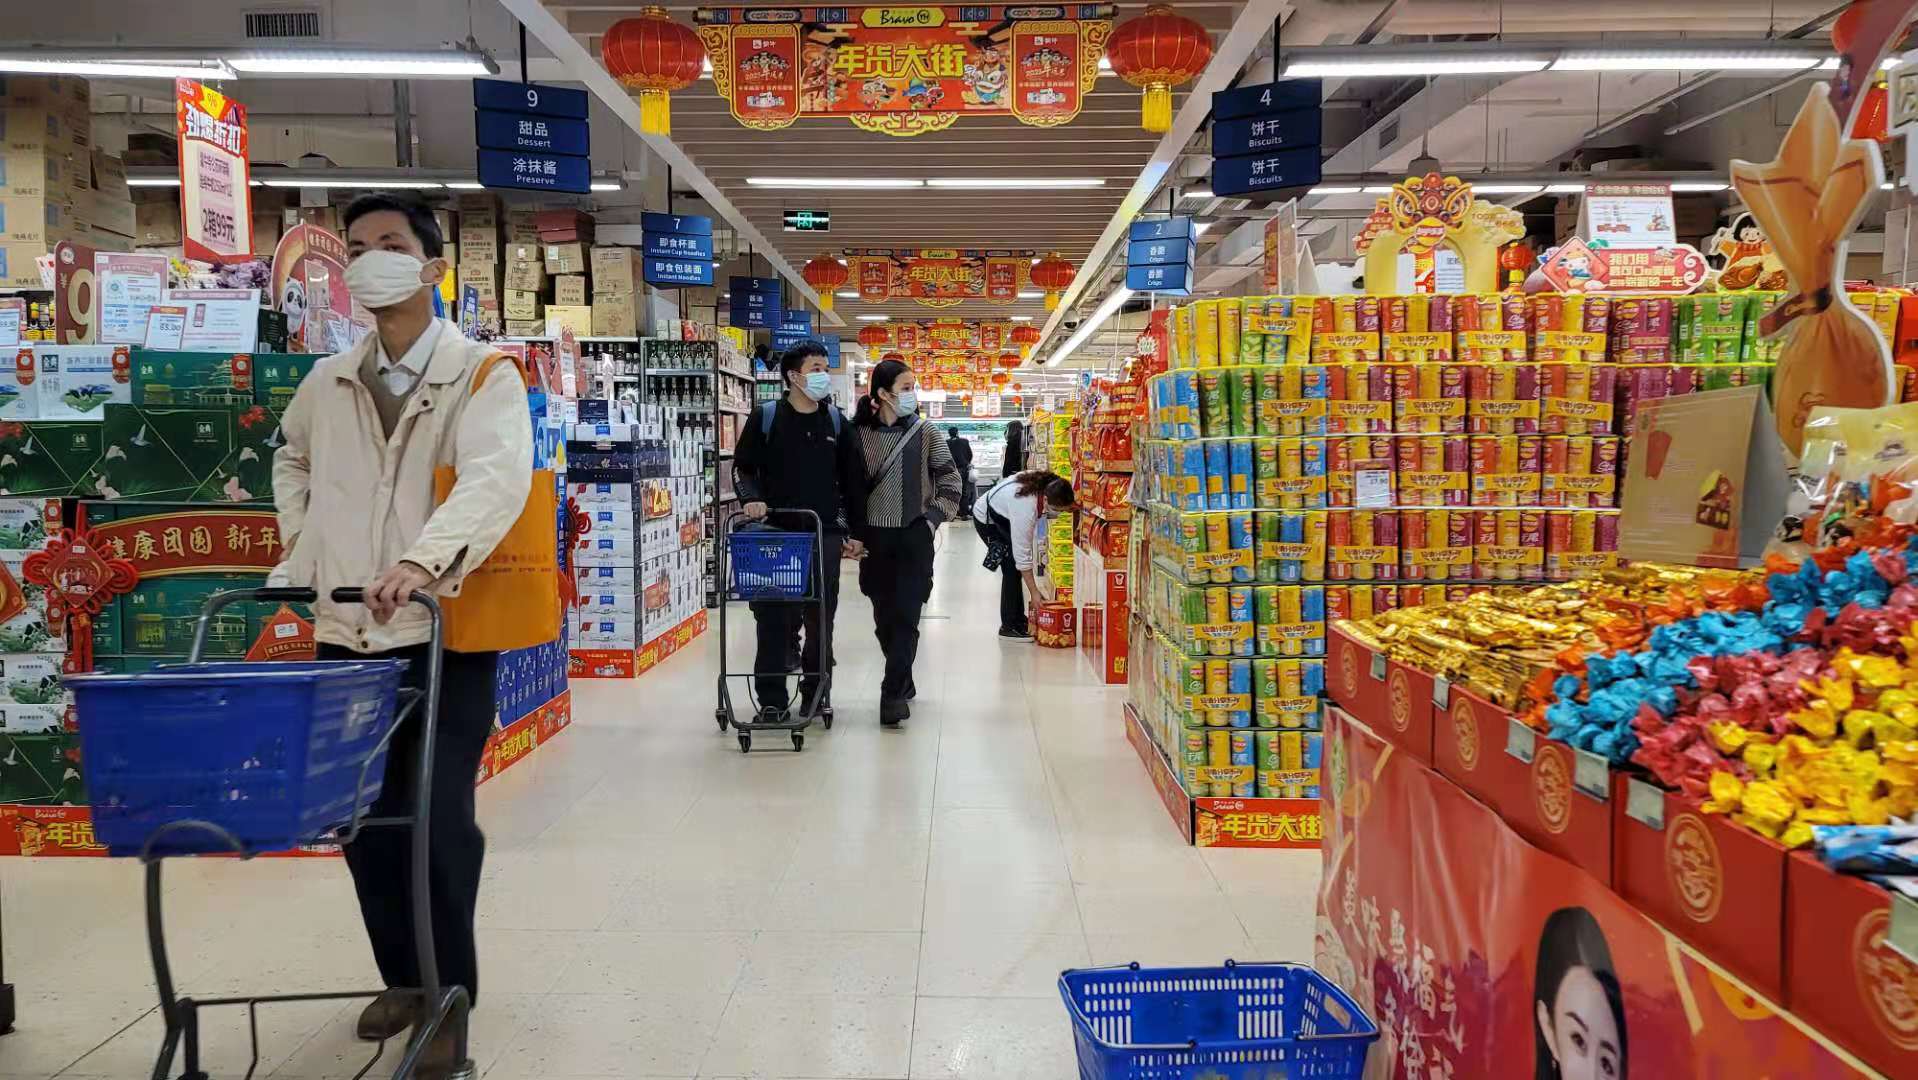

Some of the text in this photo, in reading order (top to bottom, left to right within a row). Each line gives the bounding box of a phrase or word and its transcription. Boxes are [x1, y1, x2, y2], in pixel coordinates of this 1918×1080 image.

[880, 9, 914, 25] Bravo
[833, 43, 967, 79] 年货大街
[527, 89, 538, 107] 9
[1260, 88, 1272, 106] 4
[185, 102, 241, 155] 劲爆折扣
[519, 120, 548, 137] 甜品
[1251, 120, 1280, 136] 饼干
[517, 136, 551, 148] Dessert
[1249, 136, 1282, 148] Biscuits
[512, 158, 557, 175] 涂抹酱
[1251, 158, 1280, 175] 饼干
[516, 174, 555, 185] Preserve
[1249, 175, 1283, 186] Biscuits
[202, 207, 235, 244] 2箱99元
[673, 218, 681, 230] 7
[1155, 223, 1162, 235] 2
[659, 237, 697, 249] 即食杯面
[671, 248, 682, 256] Cup
[655, 262, 702, 275] 即食包装面
[753, 279, 759, 289] 5
[224, 524, 280, 557] 新年
[1222, 813, 1322, 839] 年货大街
[46, 821, 97, 848] 年货
